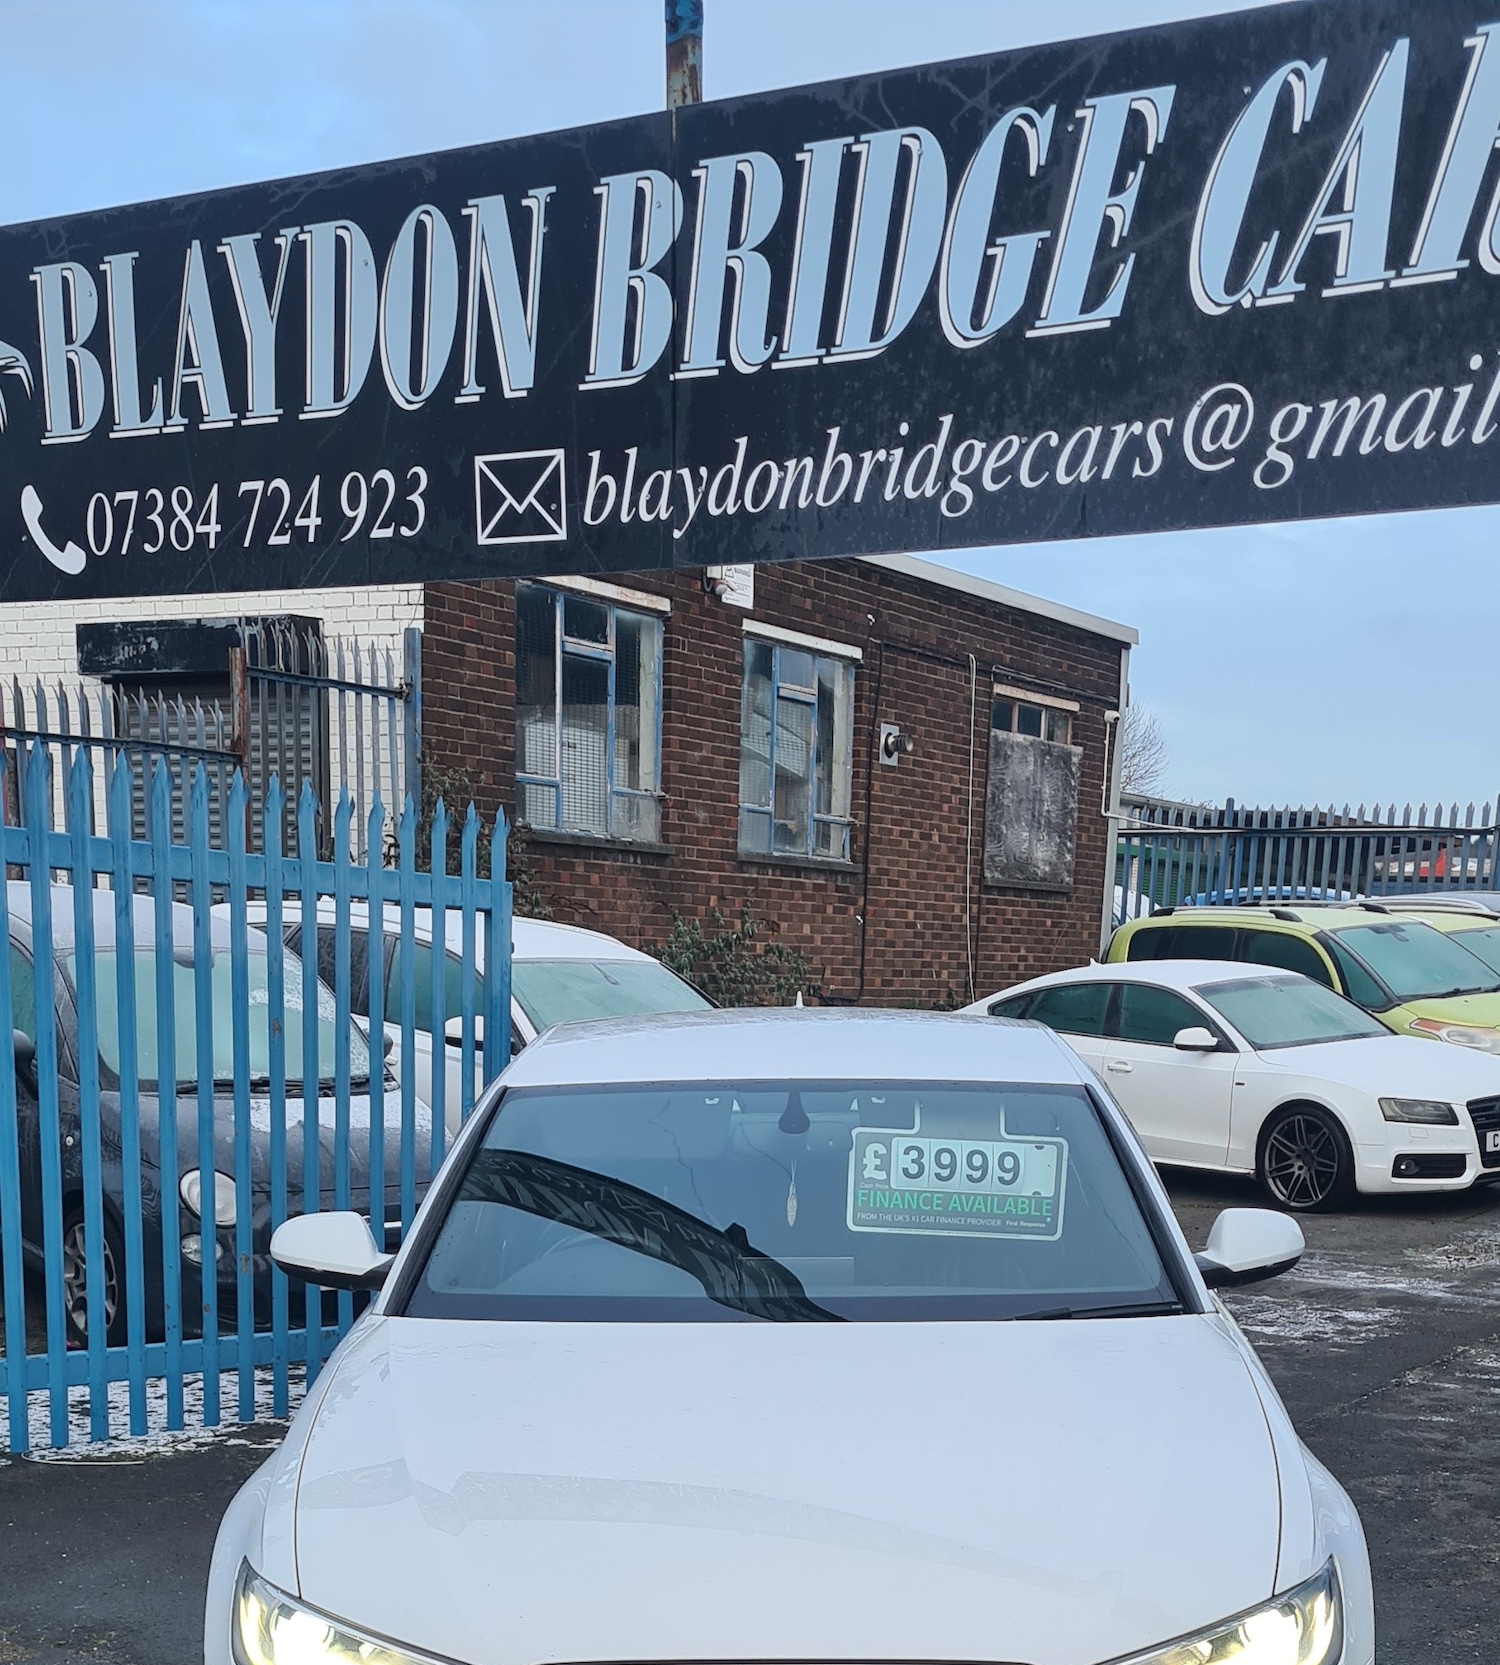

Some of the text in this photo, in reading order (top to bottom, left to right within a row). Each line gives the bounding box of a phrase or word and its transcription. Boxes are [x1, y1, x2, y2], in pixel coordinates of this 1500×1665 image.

[29, 185, 557, 446] BLAYDON
[578, 84, 1177, 392] BRIDGE
[583, 350, 1500, 540] blaydonbridgecars@gmail
[86, 465, 429, 557] 07384 724 923
[863, 1142, 1021, 1187] £ 3999
[857, 1189, 1053, 1217] FINANCE AVAILABLE
[857, 1212, 877, 1221] FROM
[879, 1213, 893, 1222] THE
[893, 1214, 911, 1222] UK'S
[920, 1215, 935, 1223] CAR
[936, 1216, 966, 1225] FINANCE
[966, 1217, 1002, 1227] PROVIDER
[1019, 1220, 1046, 1228] Response
